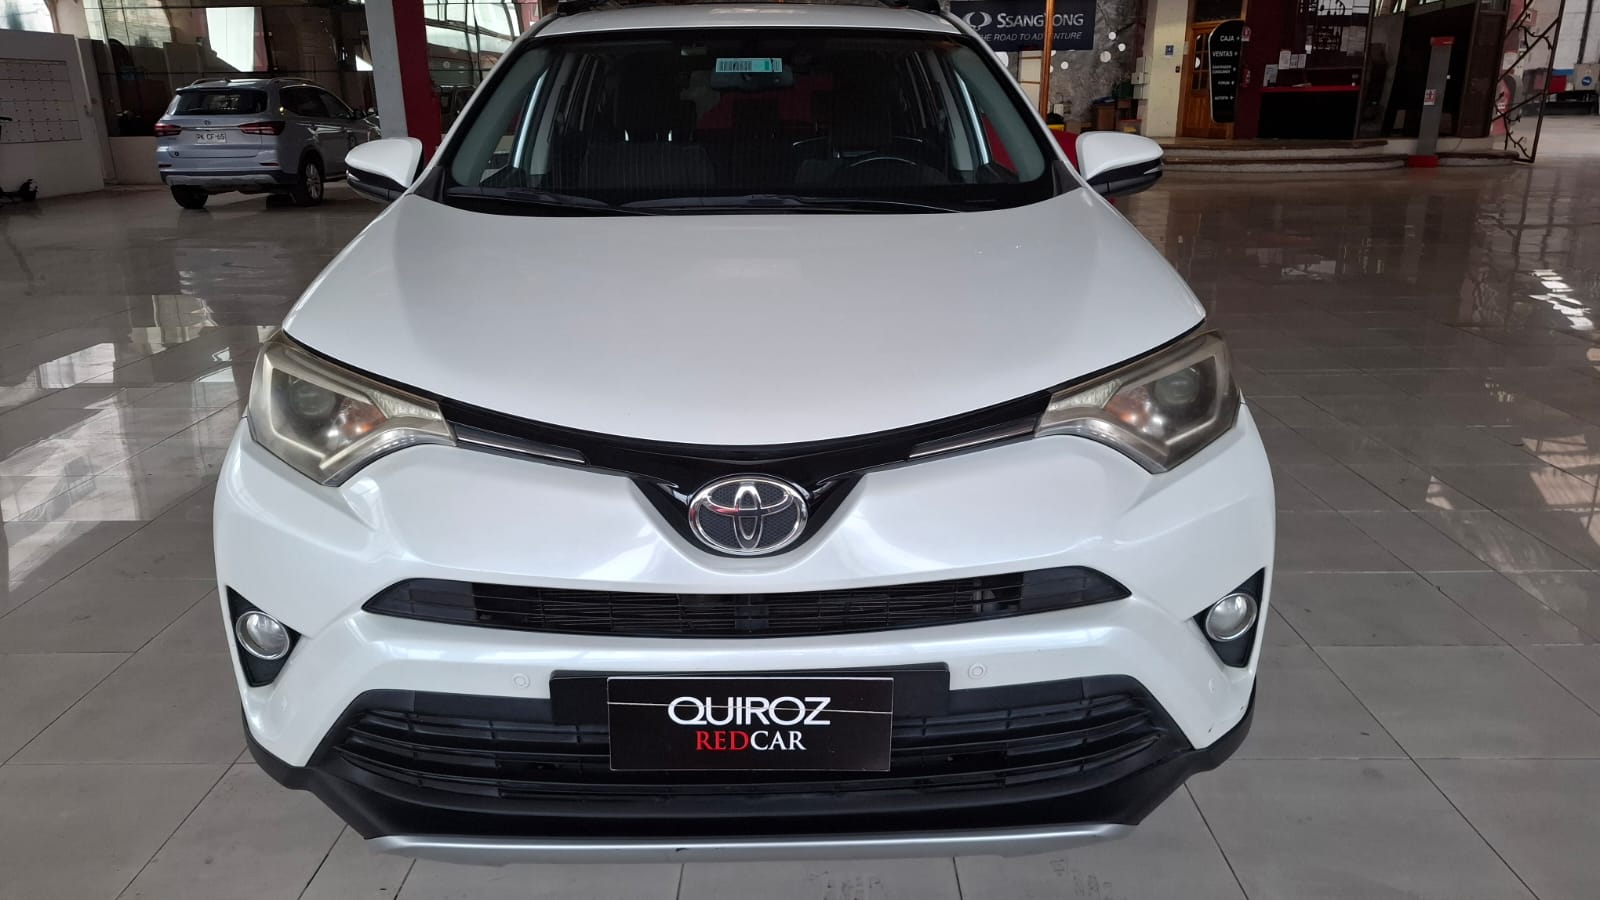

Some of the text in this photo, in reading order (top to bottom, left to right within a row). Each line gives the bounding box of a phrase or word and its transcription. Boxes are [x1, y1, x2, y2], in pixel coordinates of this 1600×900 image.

[997, 12, 1084, 28] SSANGONG
[994, 33, 1018, 41] ROAD
[1020, 33, 1030, 41] TO
[1030, 32, 1083, 41] ADNTURE
[1220, 34, 1235, 42] CAJA
[668, 696, 831, 726] QUIROZ
[695, 730, 807, 751] REDCAR
